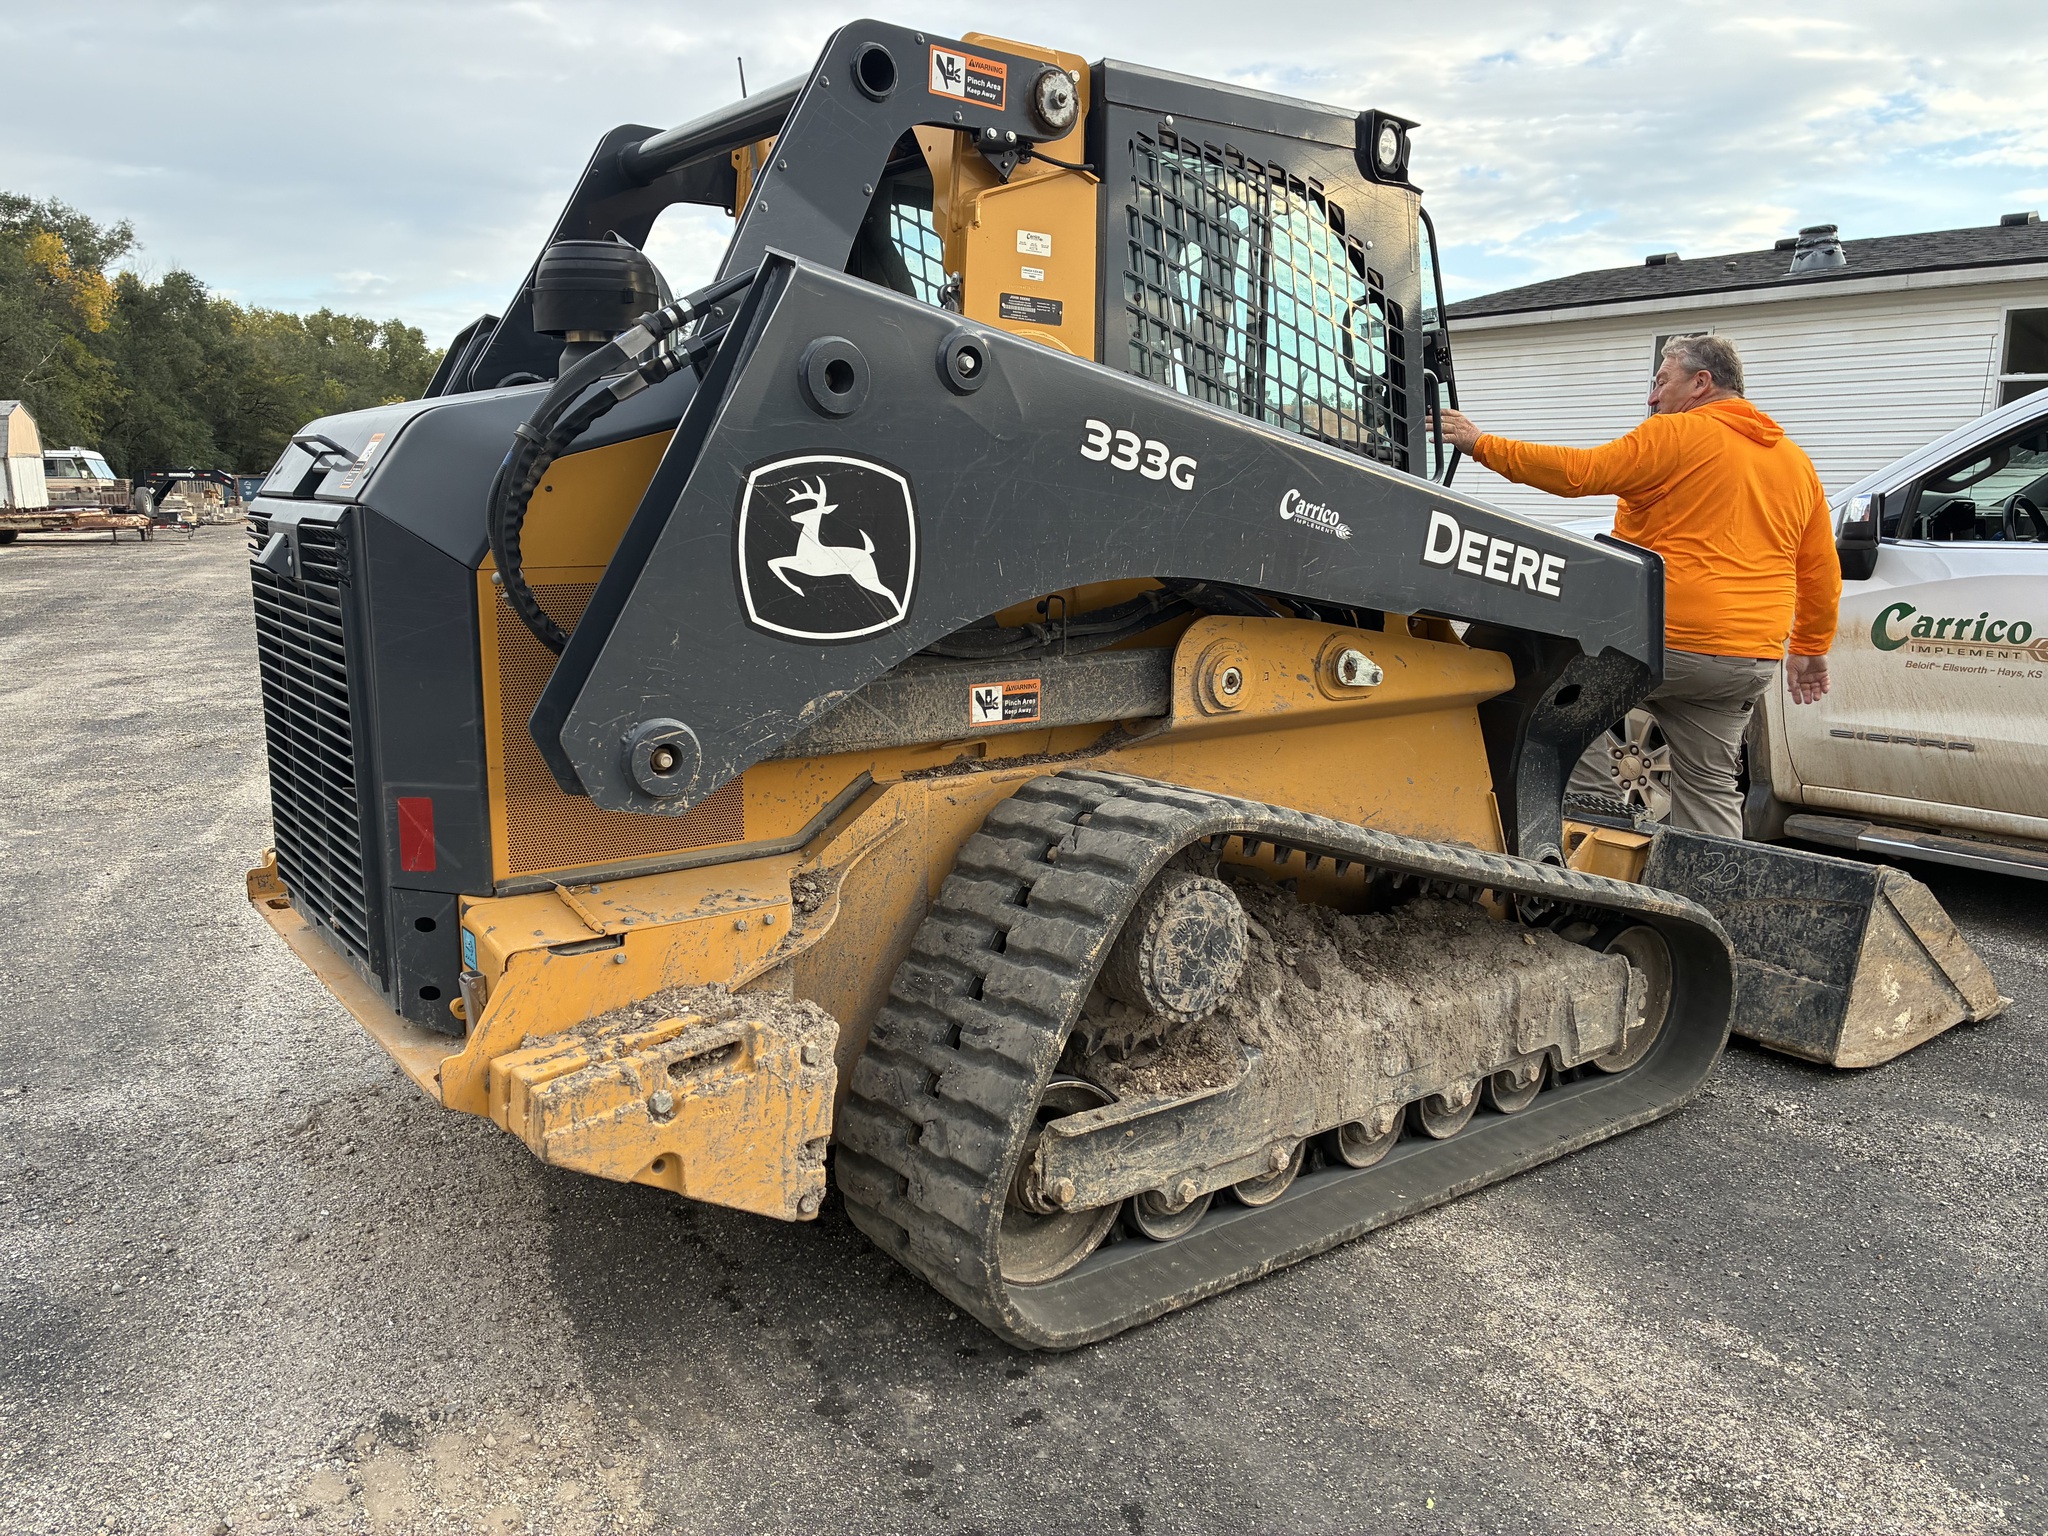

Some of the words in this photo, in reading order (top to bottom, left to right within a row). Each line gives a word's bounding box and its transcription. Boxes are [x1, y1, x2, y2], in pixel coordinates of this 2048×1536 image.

[974, 61, 1003, 75] WARNING
[967, 76, 985, 87] Pinch
[986, 80, 1001, 91] Area
[967, 86, 980, 96] Keep
[981, 89, 997, 100] Away
[1080, 419, 1198, 491] 333G
[1279, 488, 1340, 526] Carrico
[1293, 517, 1334, 535] IMPLEMENT
[1423, 510, 1566, 597] DEERE
[1870, 602, 2033, 651] Carrico
[1911, 645, 2021, 659] IMPLEMENT
[1942, 663, 1988, 674] Ellsworth
[1997, 667, 2025, 678] Hays,
[2027, 670, 2043, 679] KS
[1011, 683, 1037, 691] WARNING
[1830, 729, 1975, 752] SIERRA
